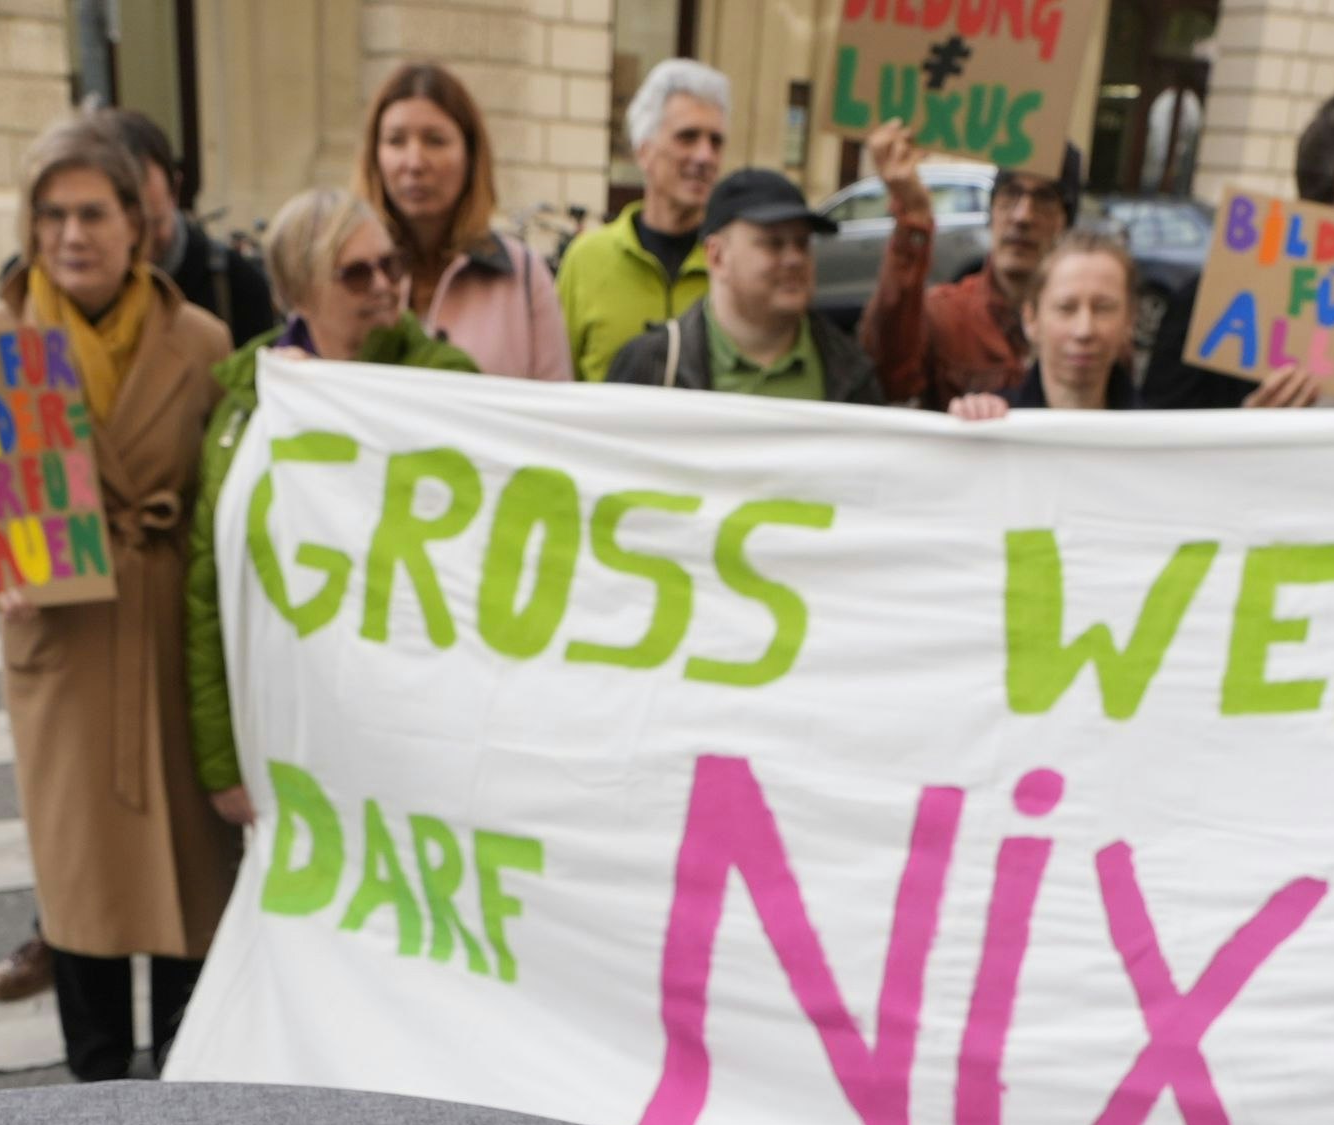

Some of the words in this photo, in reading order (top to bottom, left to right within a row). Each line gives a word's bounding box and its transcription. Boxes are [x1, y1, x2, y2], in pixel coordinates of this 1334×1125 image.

[832, 46, 1042, 166] LUXUS
[247, 431, 835, 687] GROSS
[261, 760, 544, 983] DARF
